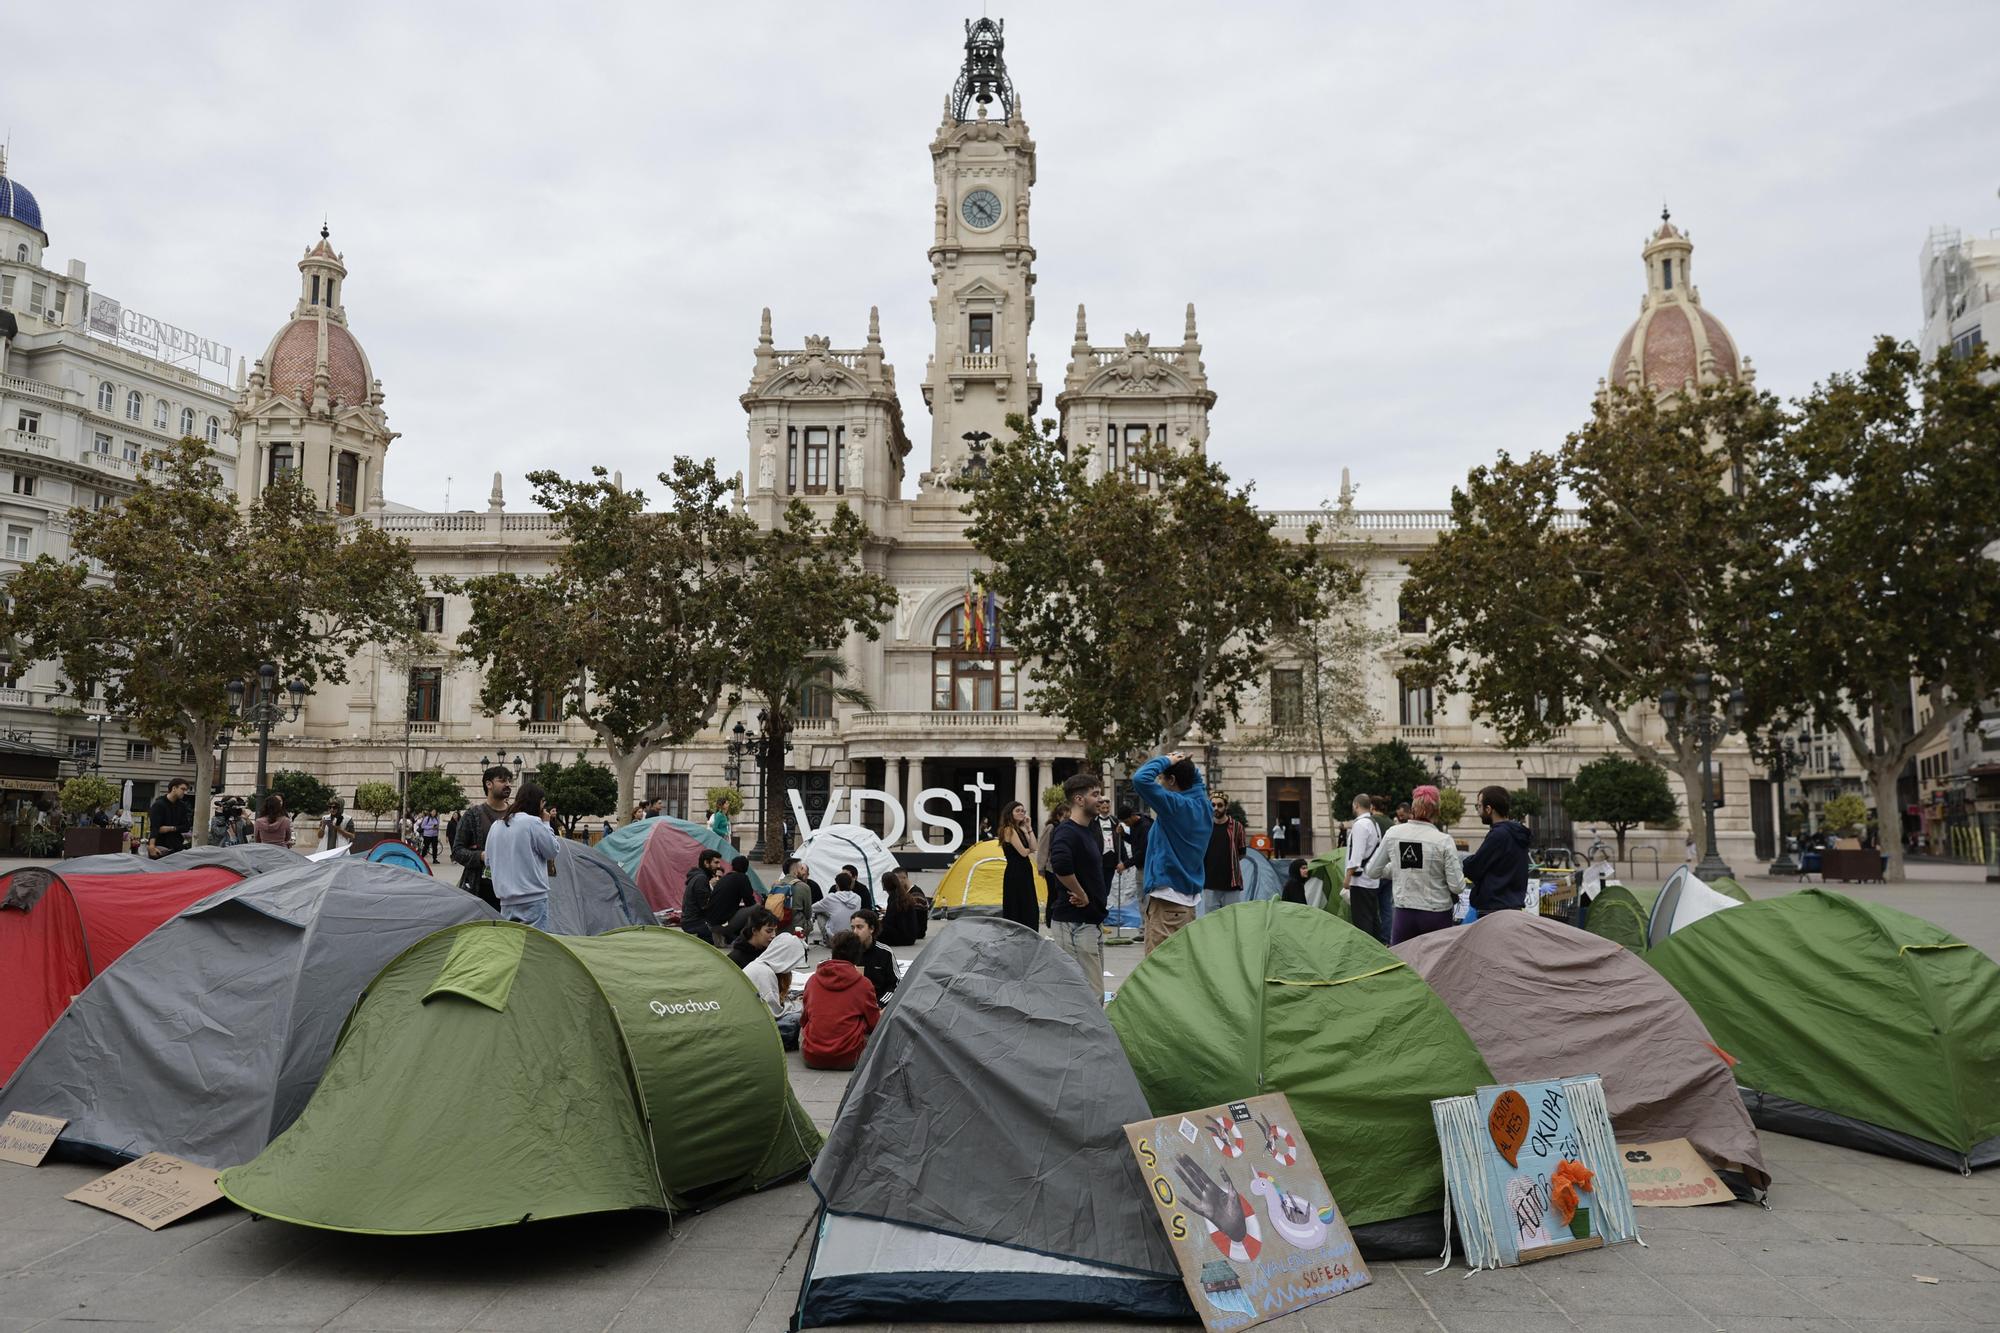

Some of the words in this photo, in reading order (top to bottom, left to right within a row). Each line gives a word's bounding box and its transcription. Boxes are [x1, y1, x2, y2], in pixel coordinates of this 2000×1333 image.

[121, 309, 231, 368] GENERALI
[787, 787, 963, 853] VDS
[649, 999, 721, 1017] Quechua
[1505, 1114, 1523, 1141] MES
[1531, 1089, 1563, 1158] OKUPA
